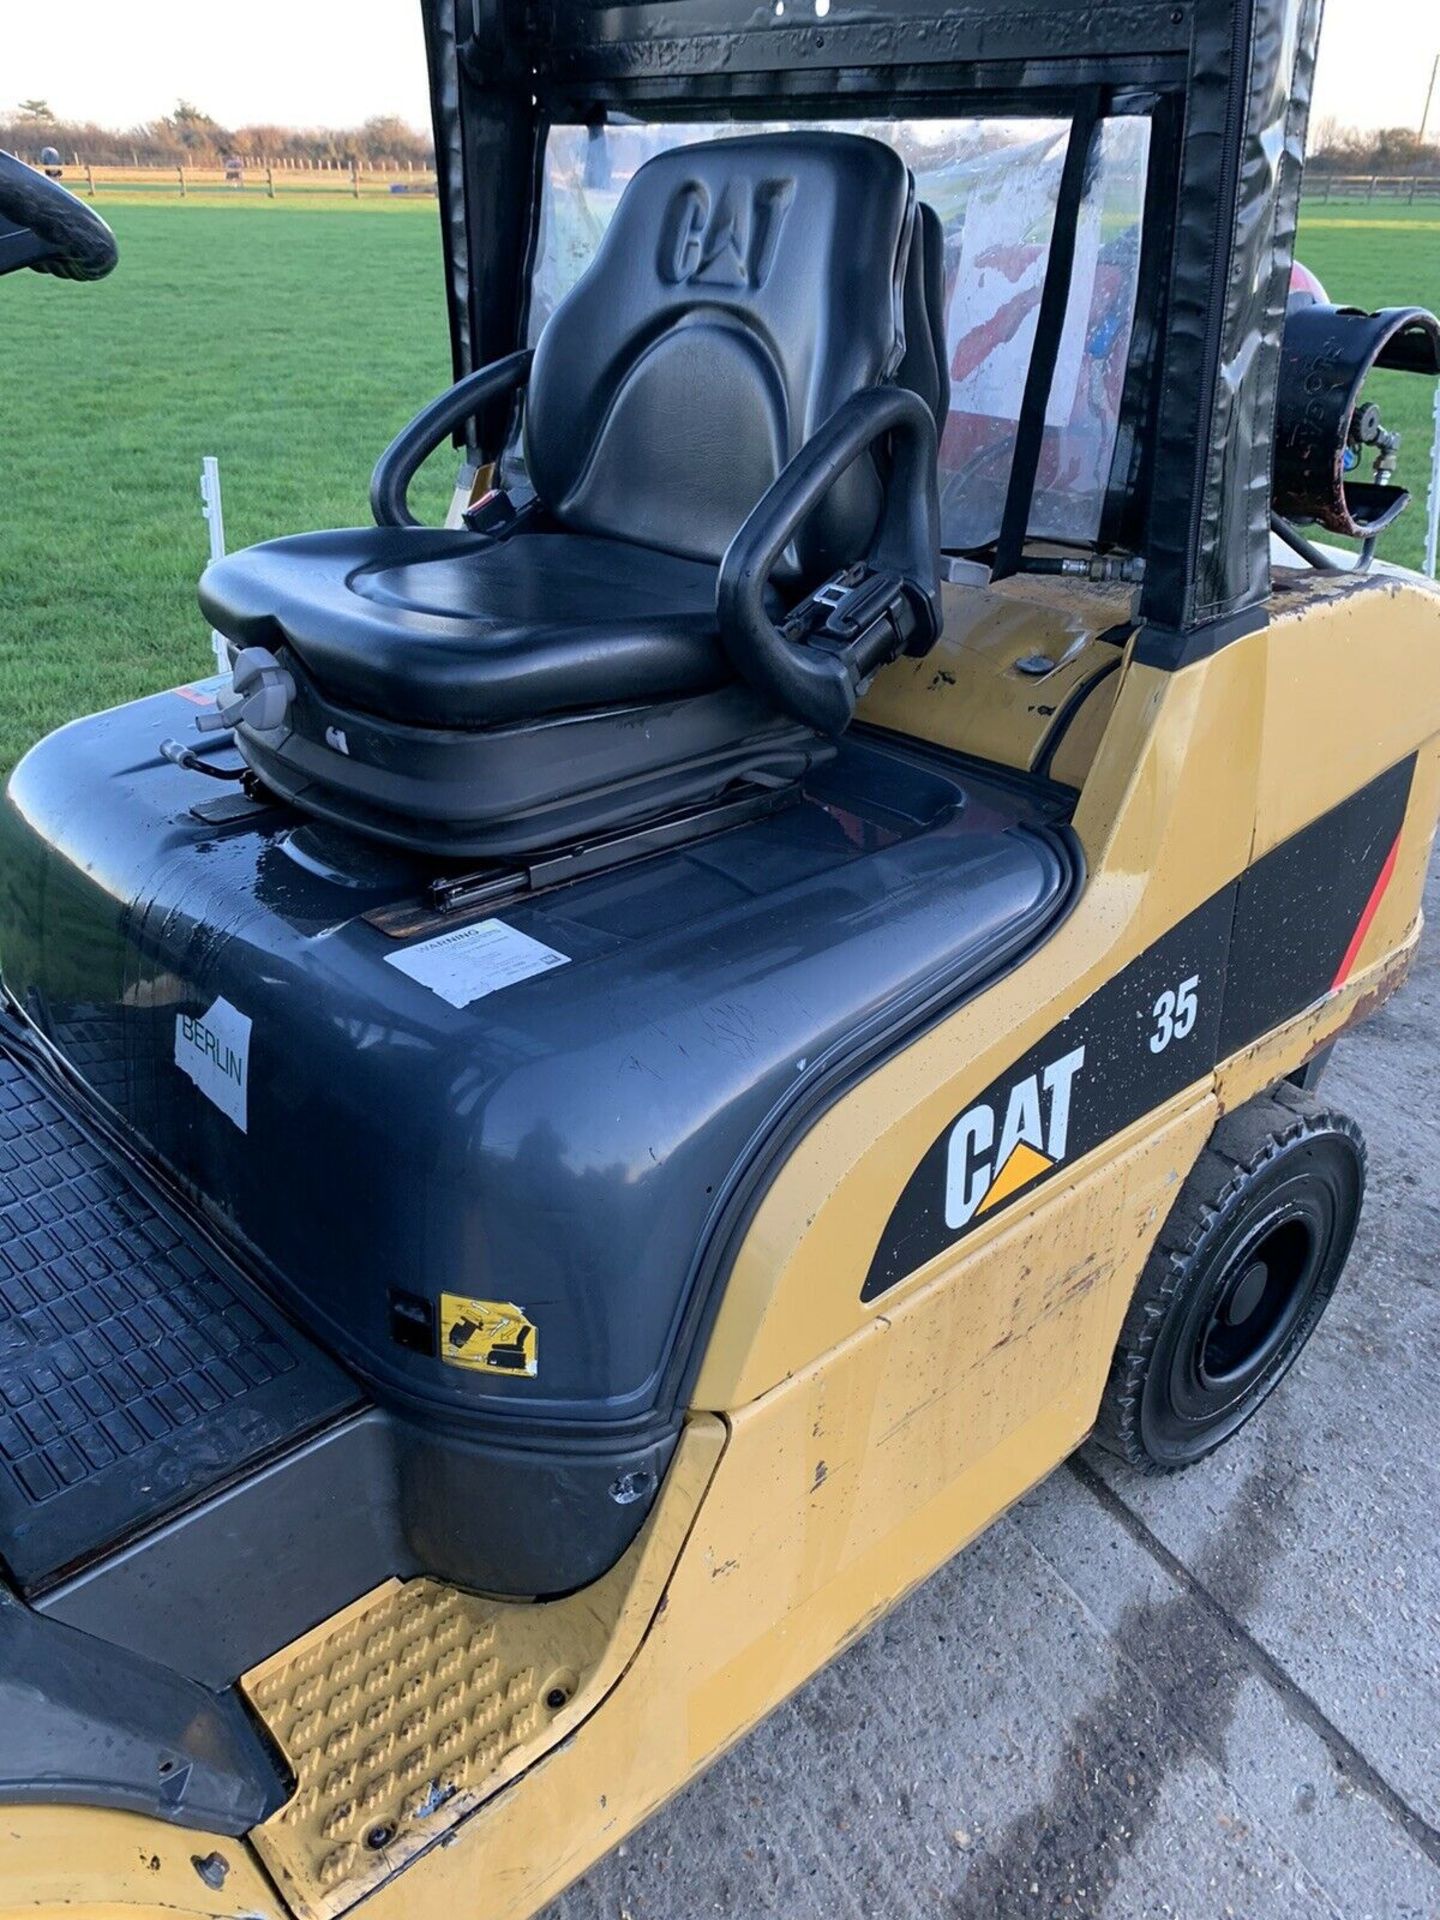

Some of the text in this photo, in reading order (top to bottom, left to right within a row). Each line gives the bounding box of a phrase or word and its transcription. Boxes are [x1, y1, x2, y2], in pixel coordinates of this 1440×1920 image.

[656, 178, 797, 292] CAT
[415, 929, 480, 953] WARNING
[182, 1014, 242, 1086] BERLIN
[1150, 974, 1199, 1054] 35
[945, 1045, 1085, 1229] CAT
